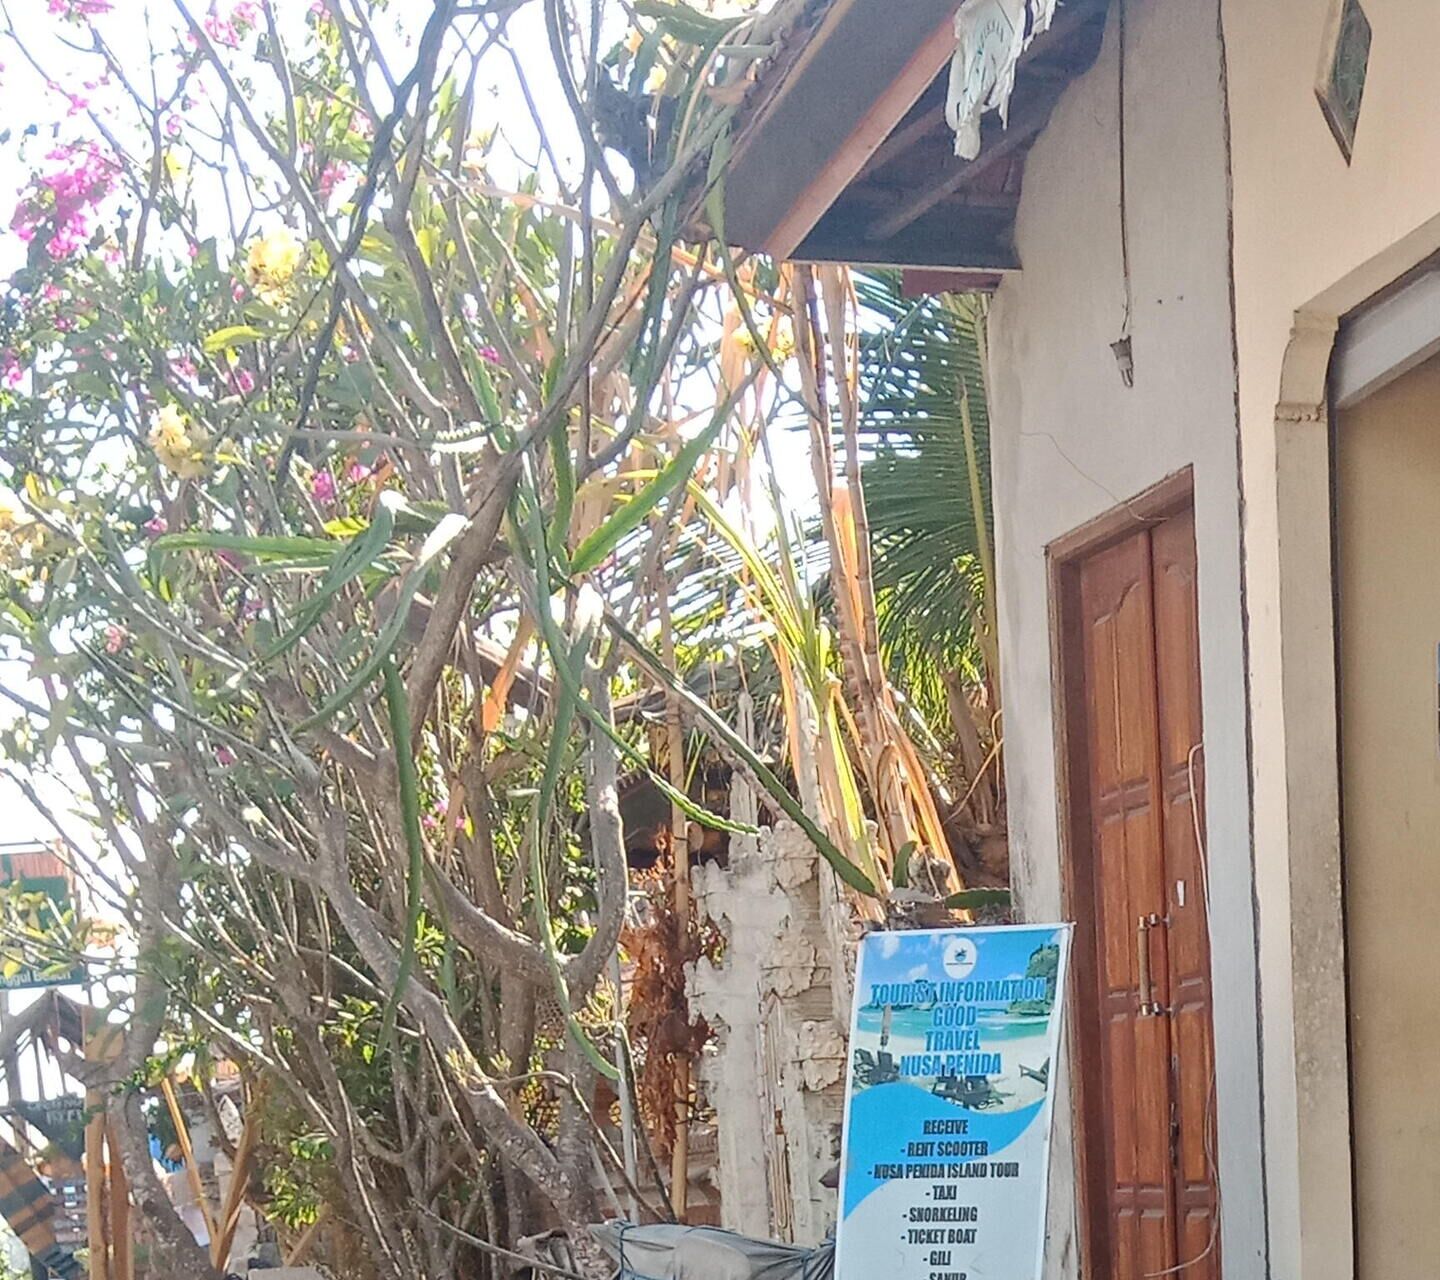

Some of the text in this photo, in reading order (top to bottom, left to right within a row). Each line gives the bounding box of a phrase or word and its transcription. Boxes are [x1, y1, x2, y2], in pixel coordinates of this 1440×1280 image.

[871, 977, 1048, 1003] TOURIST INFORMATION
[932, 1005, 977, 1027] GOOD
[925, 1030, 980, 1051] TRAVEL
[900, 1053, 1001, 1076] NUSA PENIDA
[923, 1120, 968, 1135] RECEIVE
[907, 1140, 988, 1157] RENT SCOOTER
[873, 1162, 1019, 1179] NUSA PENIDA ISLAND TOUR
[933, 1186, 957, 1200] TAXI
[909, 1207, 978, 1222] SNORKELING
[908, 1229, 977, 1244] TICKET BOAT
[929, 1251, 951, 1266] GILI
